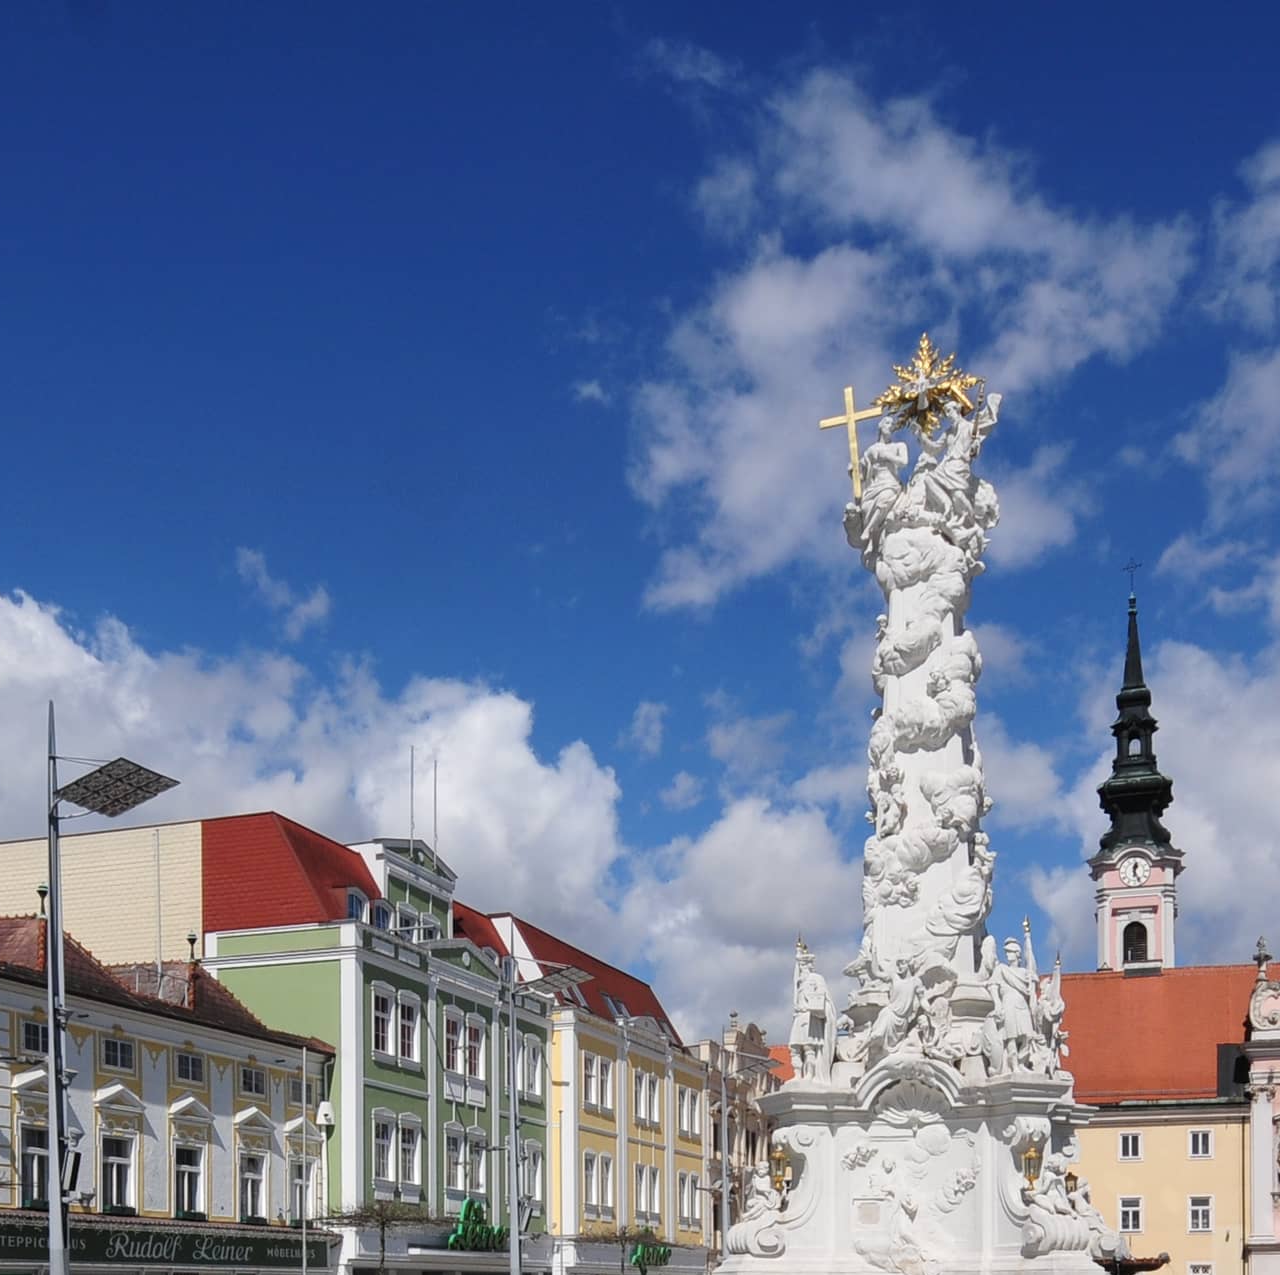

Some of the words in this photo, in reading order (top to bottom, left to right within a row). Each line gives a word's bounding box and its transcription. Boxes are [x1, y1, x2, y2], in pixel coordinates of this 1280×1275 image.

[0, 1235, 86, 1250] TEPPICUS
[105, 1232, 182, 1261] Rudolf
[192, 1235, 253, 1262] Leiner
[266, 1245, 317, 1259] MÖBELHUS
